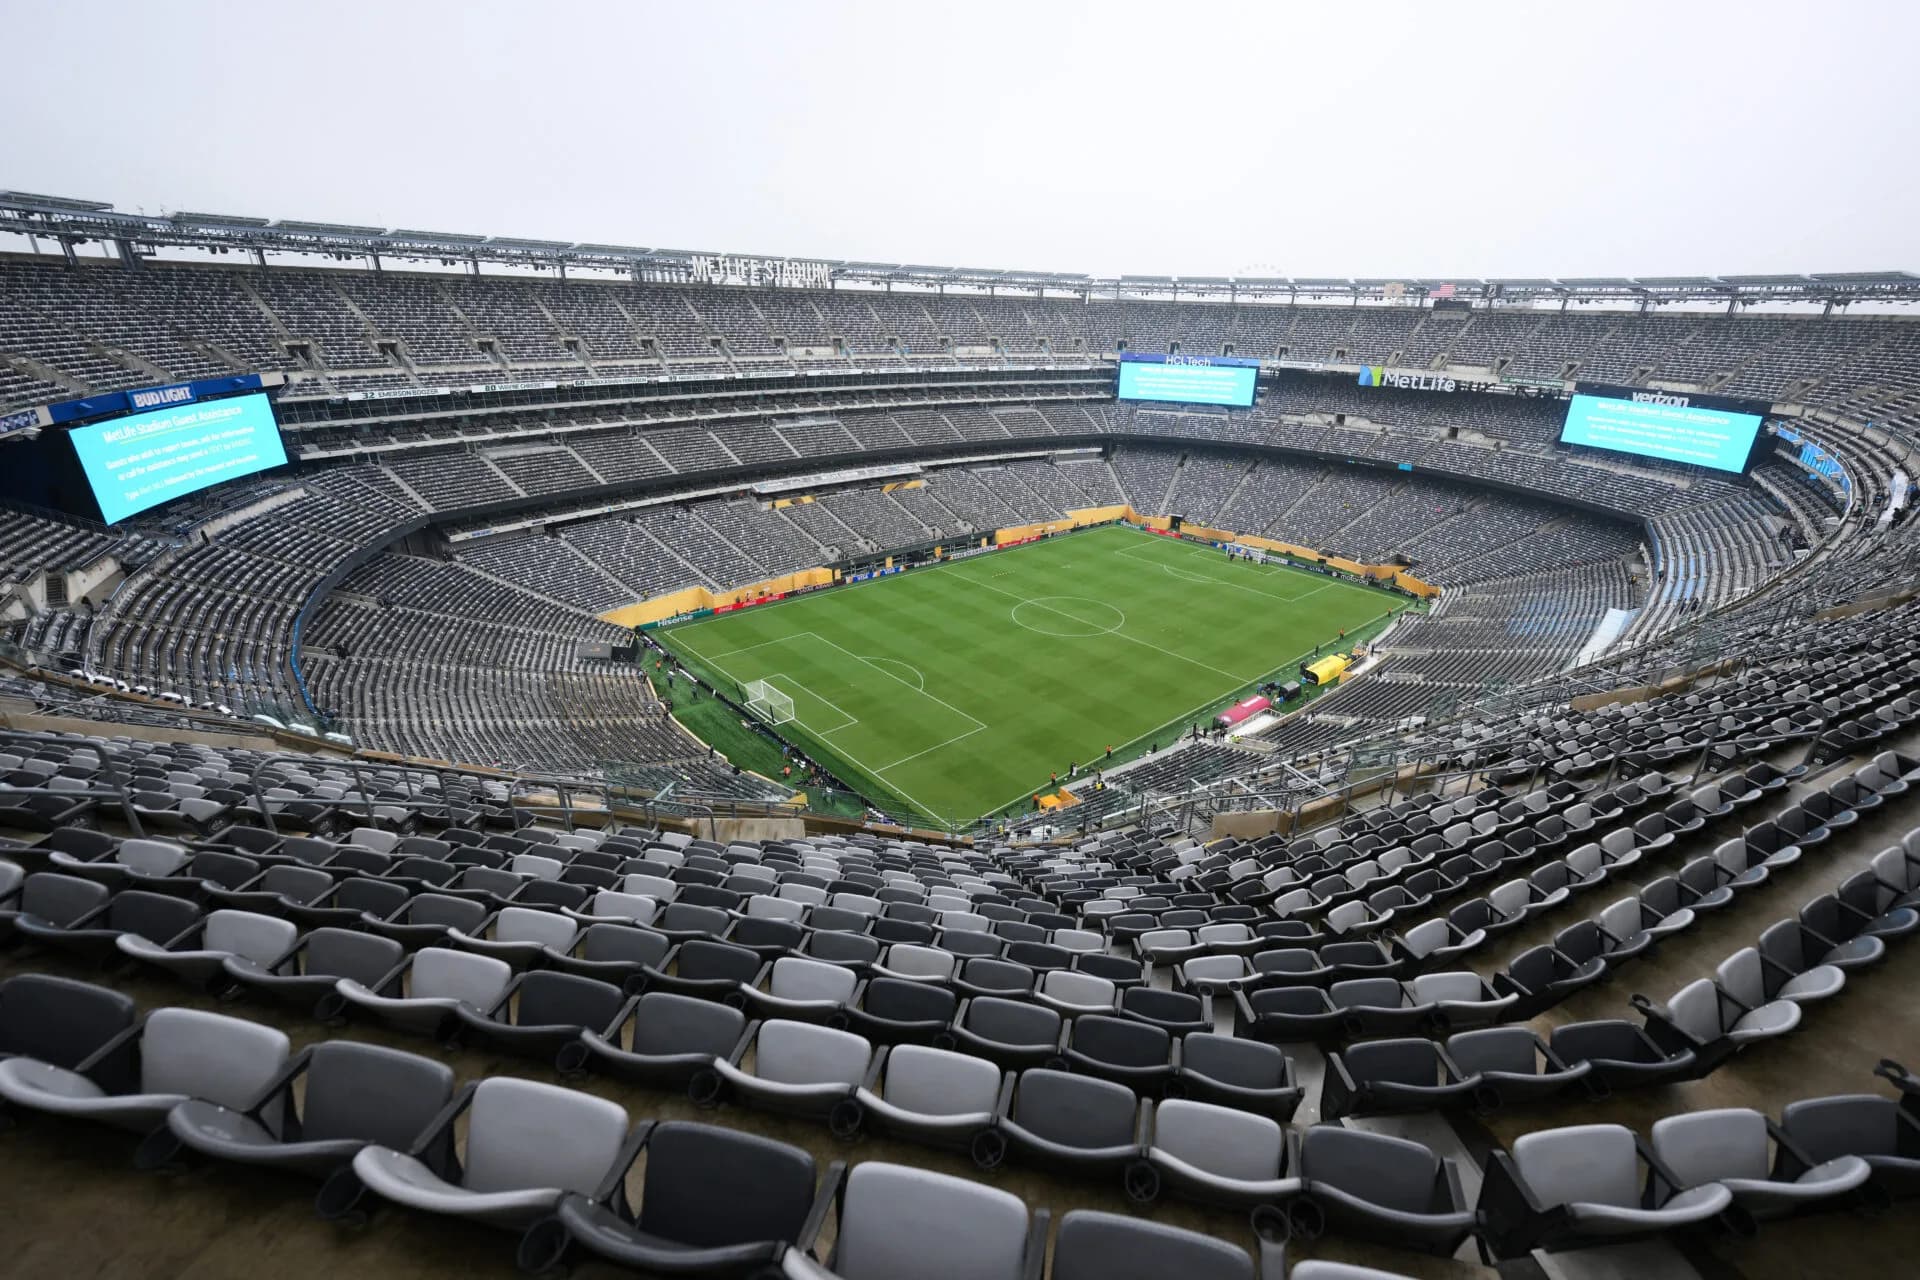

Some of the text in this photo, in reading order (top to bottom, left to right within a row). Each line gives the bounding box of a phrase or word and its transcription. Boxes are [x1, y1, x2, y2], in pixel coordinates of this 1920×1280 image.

[691, 255, 830, 284] METLIFE STADIUM
[1166, 355, 1211, 367] HCLTech
[1383, 370, 1456, 392] MetLife
[133, 387, 192, 408] BUD LIGHT
[361, 388, 438, 399] 32 EMERSON BOOZER
[1632, 391, 1690, 408] verizon
[102, 425, 136, 442] MetLife
[135, 419, 172, 434] Stadium
[1340, 574, 1369, 586] motorola
[657, 614, 694, 628] Hisense
